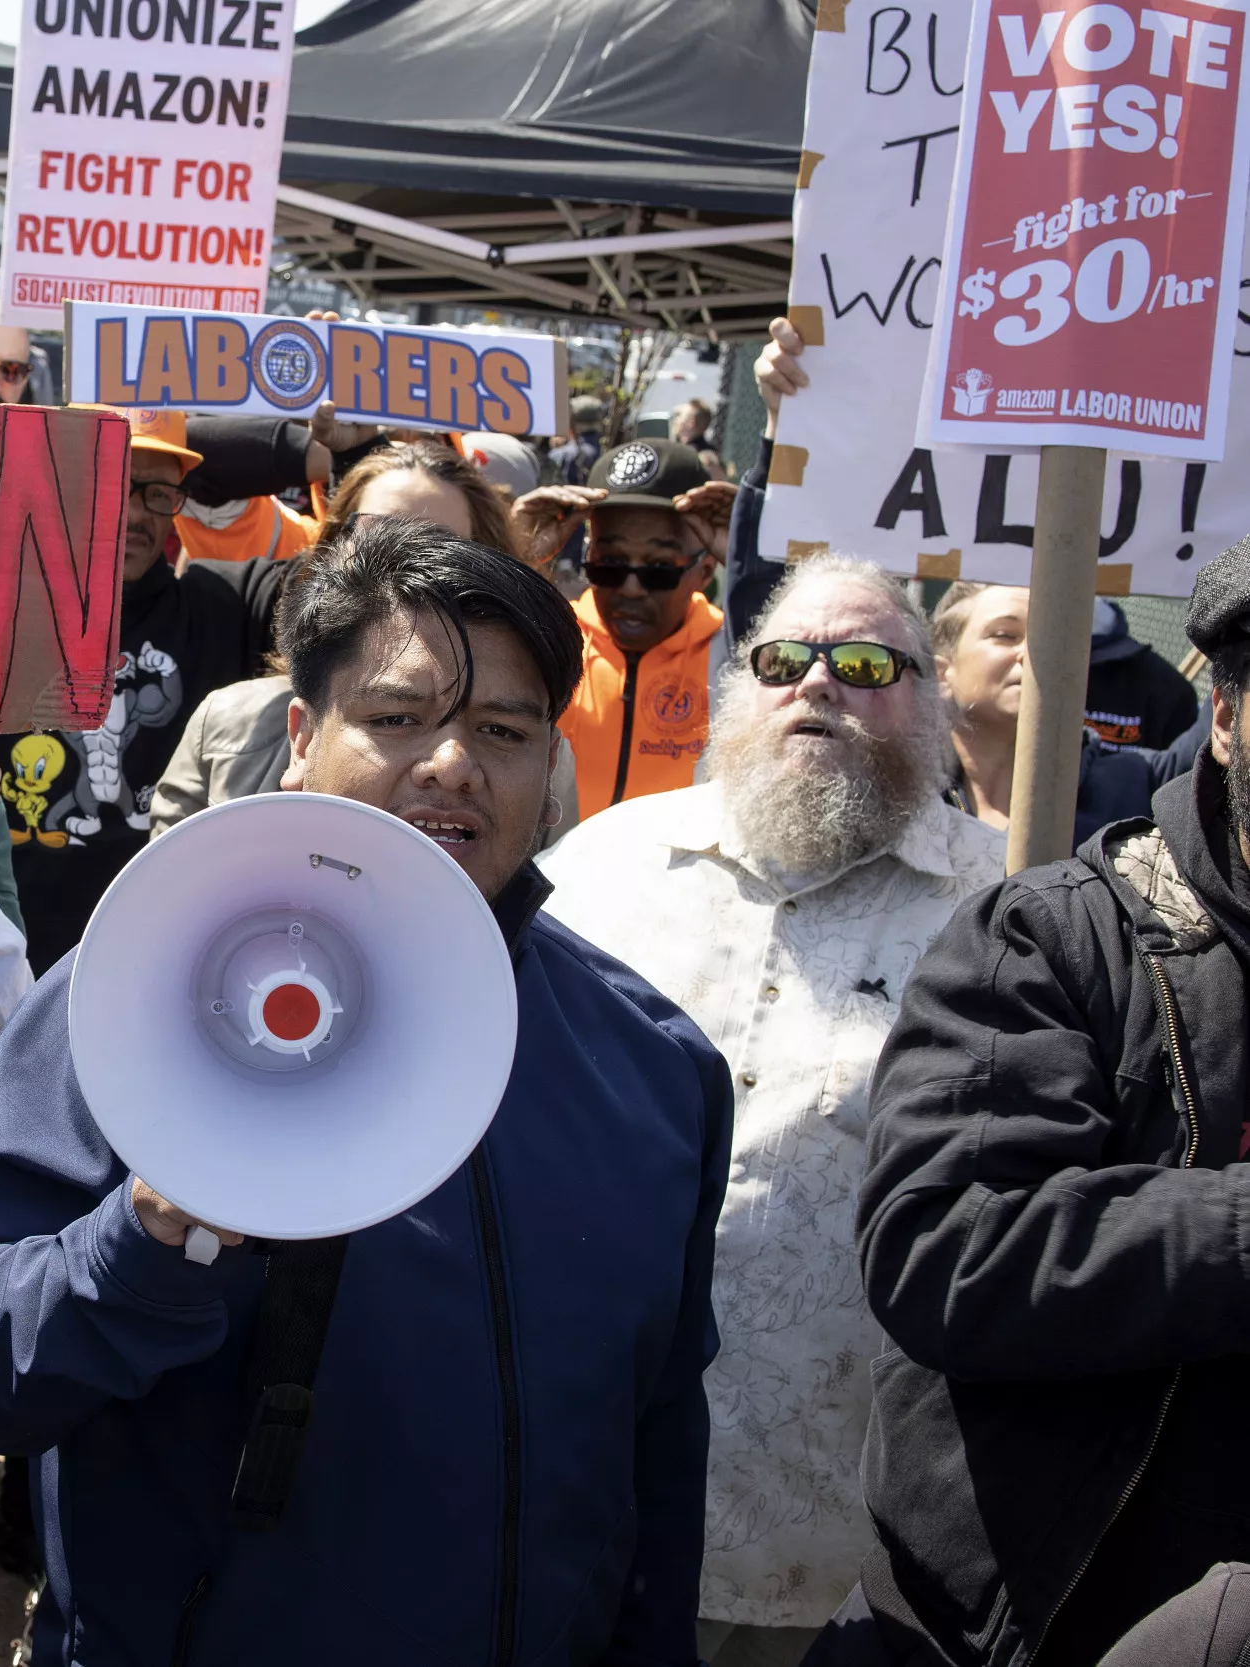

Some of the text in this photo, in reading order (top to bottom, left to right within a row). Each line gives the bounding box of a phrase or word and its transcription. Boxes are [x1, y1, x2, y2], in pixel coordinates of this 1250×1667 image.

[34, 0, 283, 50] UNIONIZE
[998, 4, 1232, 90] VOTE
[32, 65, 269, 128] AMAZON!
[990, 84, 1183, 160] YES!
[38, 151, 252, 202] FIGHT FOR
[16, 213, 264, 267] REVOLUTION!
[1012, 185, 1186, 254] fight for
[959, 238, 1215, 347] $30/hr
[95, 316, 533, 435] LABORERS
[996, 387, 1203, 433] amazon LABOR UNION
[873, 447, 1207, 562] ALU!
